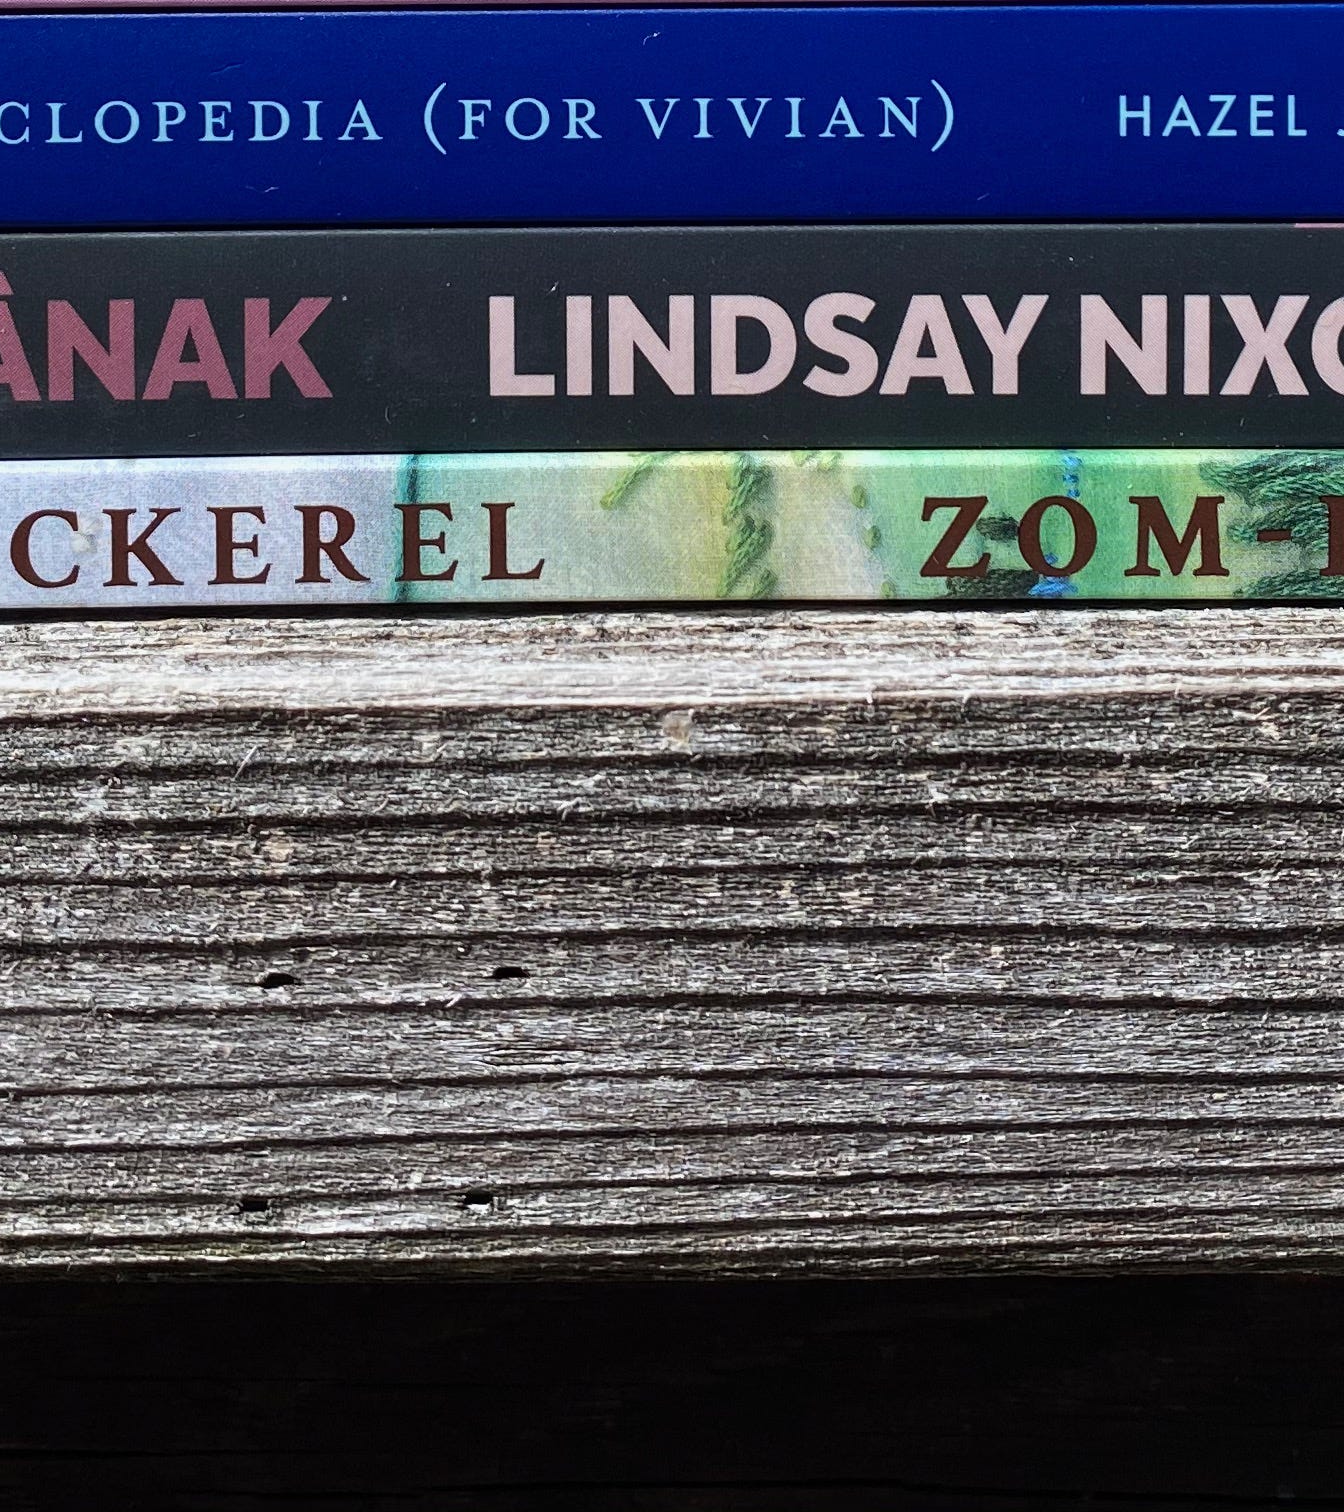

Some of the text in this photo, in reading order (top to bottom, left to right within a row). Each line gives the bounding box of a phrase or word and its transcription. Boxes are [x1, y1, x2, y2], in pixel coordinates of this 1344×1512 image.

[424, 82, 603, 154] (FOR
[635, 80, 955, 152] VIVIAN)
[1119, 94, 1308, 137] HAZEL
[488, 292, 1049, 398] LINDSAY
